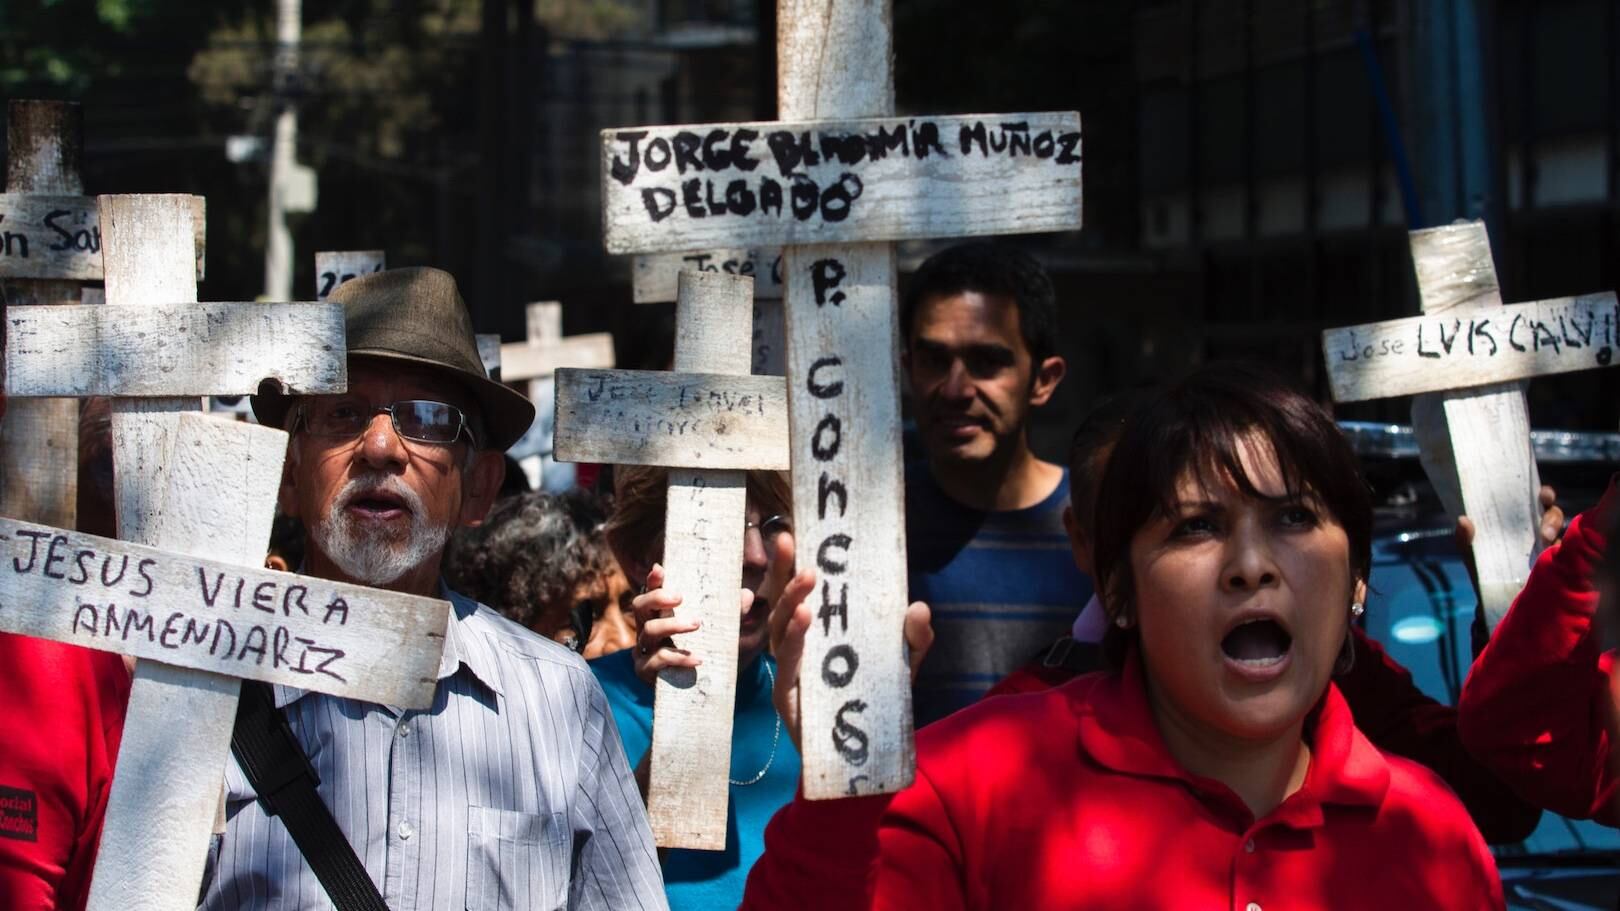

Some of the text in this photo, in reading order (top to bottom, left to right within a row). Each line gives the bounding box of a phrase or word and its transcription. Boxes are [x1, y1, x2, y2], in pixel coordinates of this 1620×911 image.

[611, 129, 760, 186] JORGE
[959, 121, 1081, 165] MUÑOZ
[641, 173, 863, 223] DELGADO
[13, 530, 349, 625] JESUS VIERA
